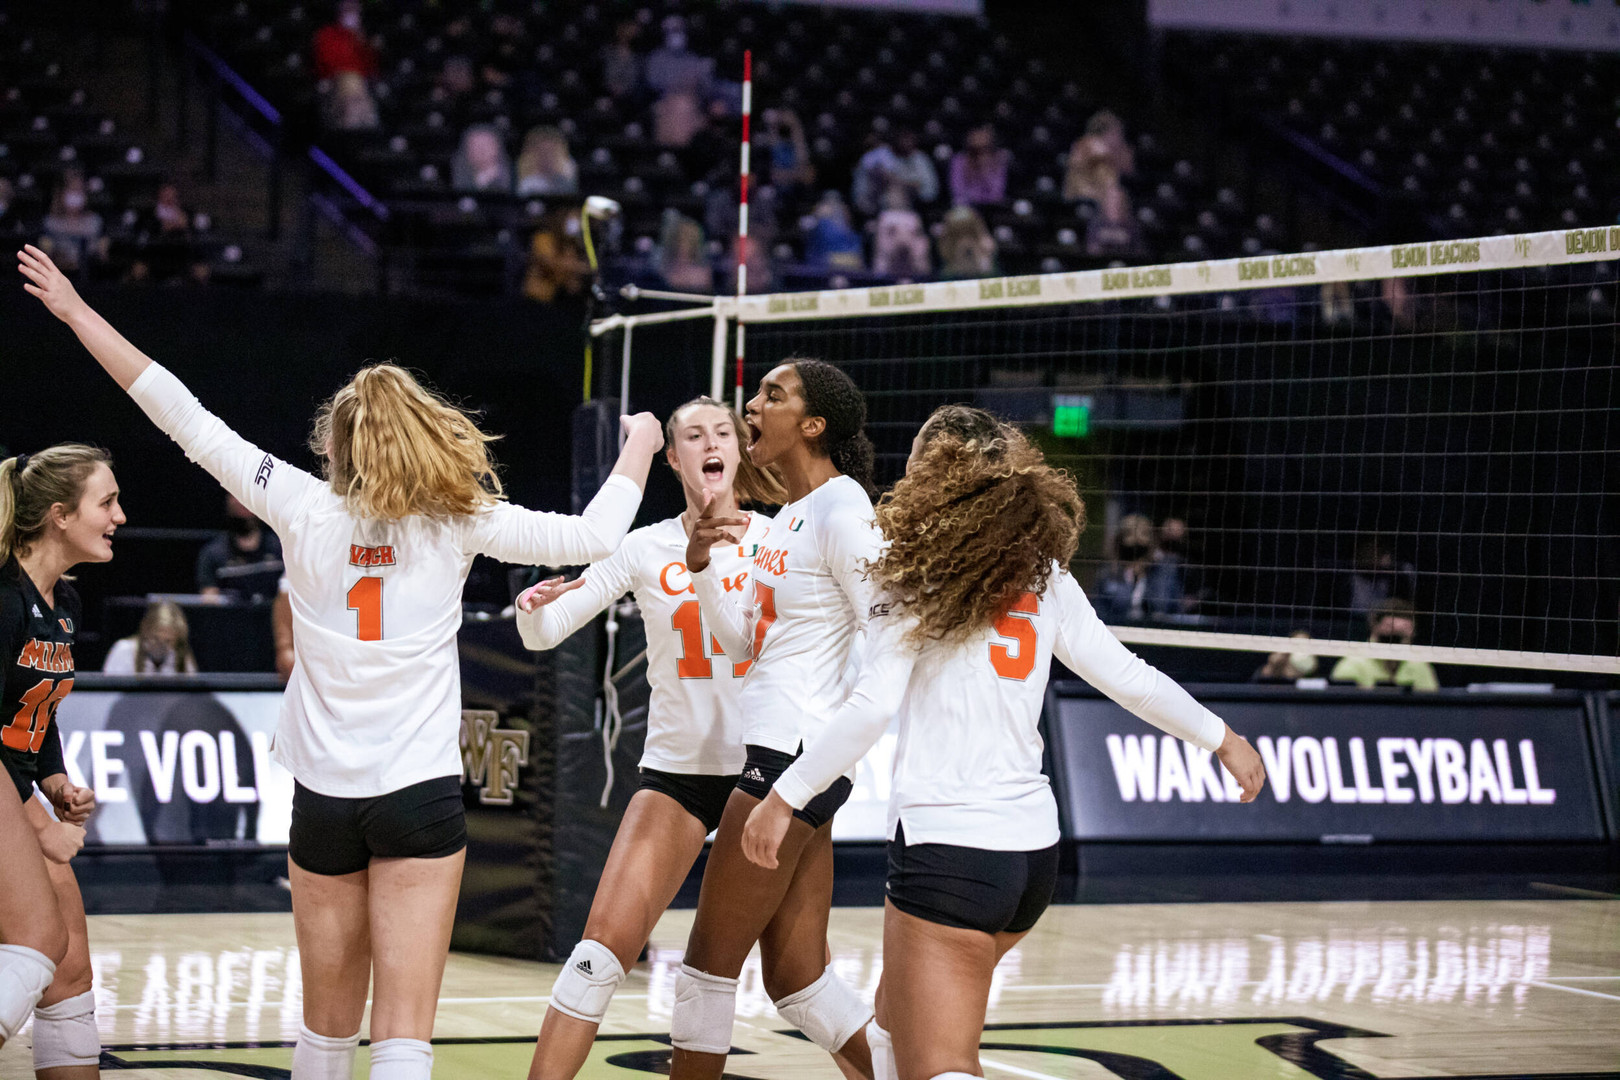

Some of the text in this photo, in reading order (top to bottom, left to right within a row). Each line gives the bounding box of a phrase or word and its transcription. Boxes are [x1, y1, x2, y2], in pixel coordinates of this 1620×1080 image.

[1566, 229, 1606, 255] DEMON
[255, 453, 274, 490] ACC
[753, 527, 789, 576] anes
[347, 576, 384, 642] 1
[987, 591, 1040, 682] 5
[1256, 736, 1556, 805] VOLLEYBALL
